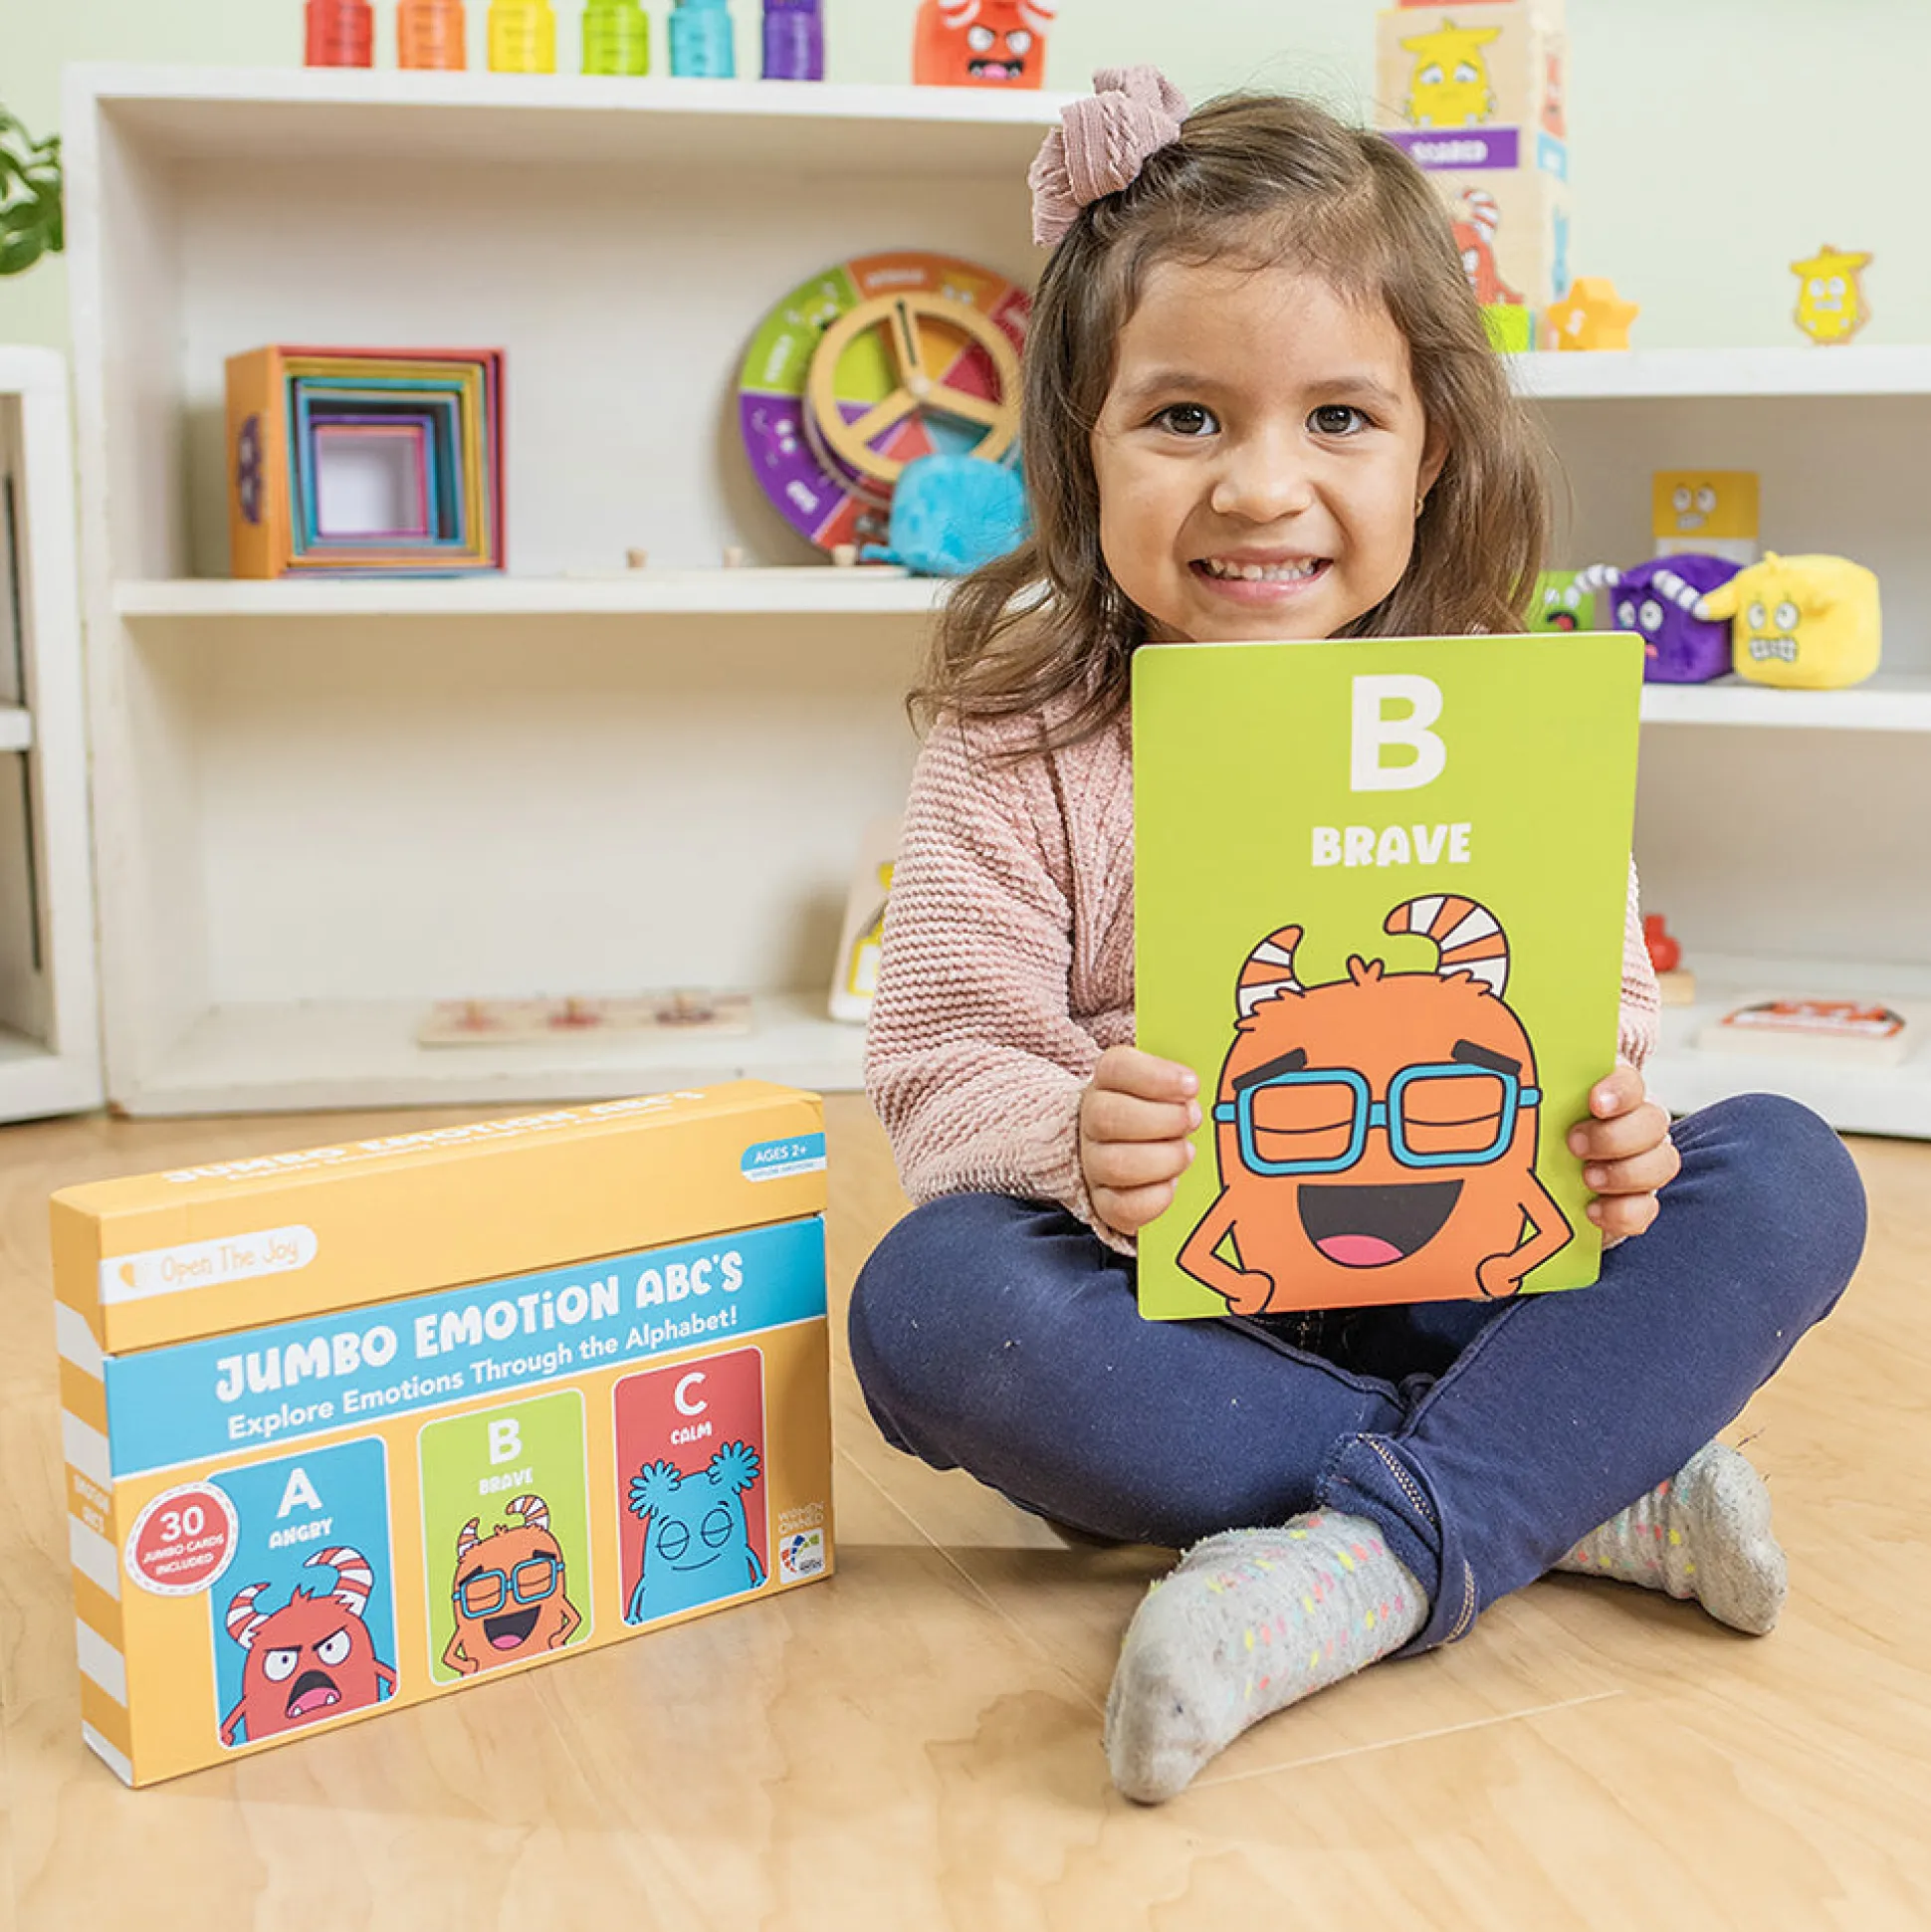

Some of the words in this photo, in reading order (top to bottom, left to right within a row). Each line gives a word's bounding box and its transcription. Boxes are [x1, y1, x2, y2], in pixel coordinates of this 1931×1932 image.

[1351, 674, 1447, 792] B
[1311, 822, 1472, 867] BRAVE
[753, 1145, 789, 1165] AGES
[161, 1255, 213, 1285] Open
[218, 1245, 256, 1272] The
[263, 1237, 298, 1265] Joy
[215, 1325, 397, 1402] JUMBO
[636, 1250, 744, 1309] ABC'S
[227, 1400, 334, 1439] Explore
[342, 1372, 465, 1414] Emotions
[470, 1341, 572, 1384] Through
[579, 1335, 618, 1360] the
[626, 1305, 738, 1350] Alphabet!
[674, 1372, 708, 1415] C
[488, 1418, 523, 1465] B
[671, 1421, 712, 1444] CALM
[277, 1467, 322, 1518] A
[479, 1468, 533, 1495] BRAVE
[160, 1506, 204, 1542] 30
[143, 1545, 184, 1563] JUMBO
[155, 1553, 214, 1575] INCLUDED
